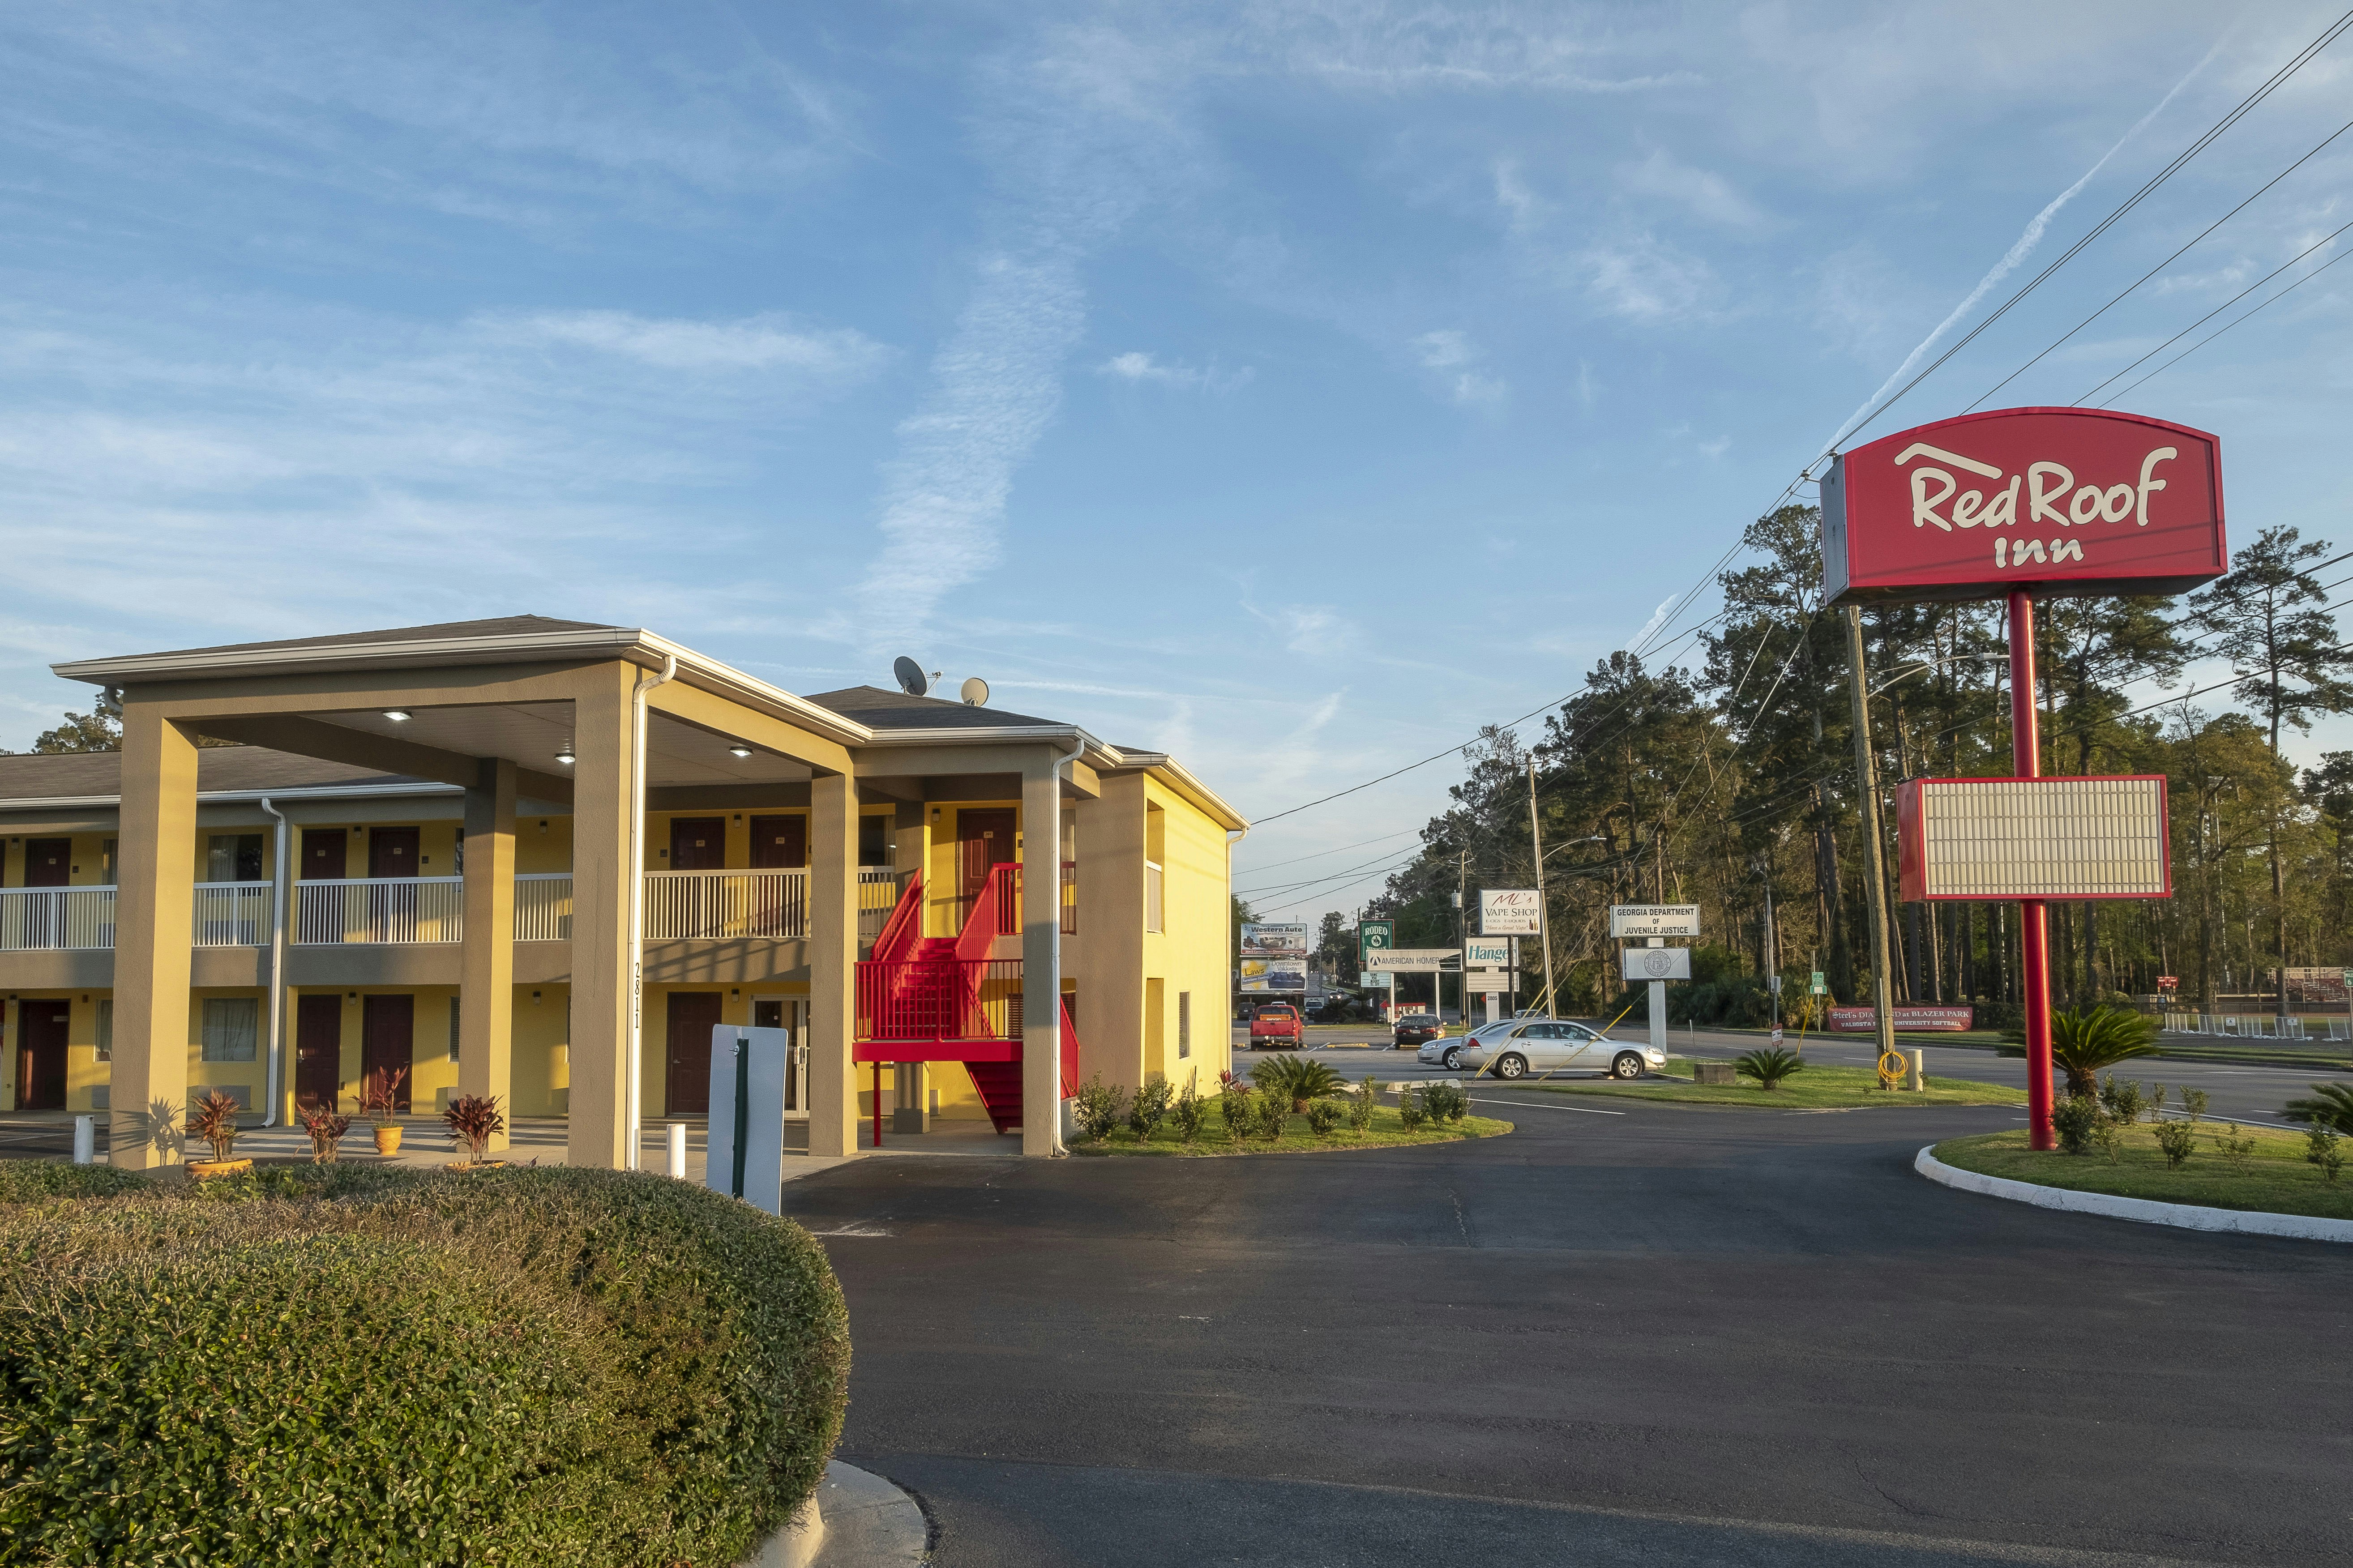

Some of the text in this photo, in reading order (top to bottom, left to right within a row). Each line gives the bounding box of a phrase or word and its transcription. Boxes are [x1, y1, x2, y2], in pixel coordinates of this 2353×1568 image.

[1485, 908, 1537, 917] VAPE SHOP
[1650, 908, 1694, 916] DEPARTMENT
[1365, 926, 1388, 936] RODEO
[1468, 945, 1516, 962] Hange
[1245, 968, 1264, 976] Laws
